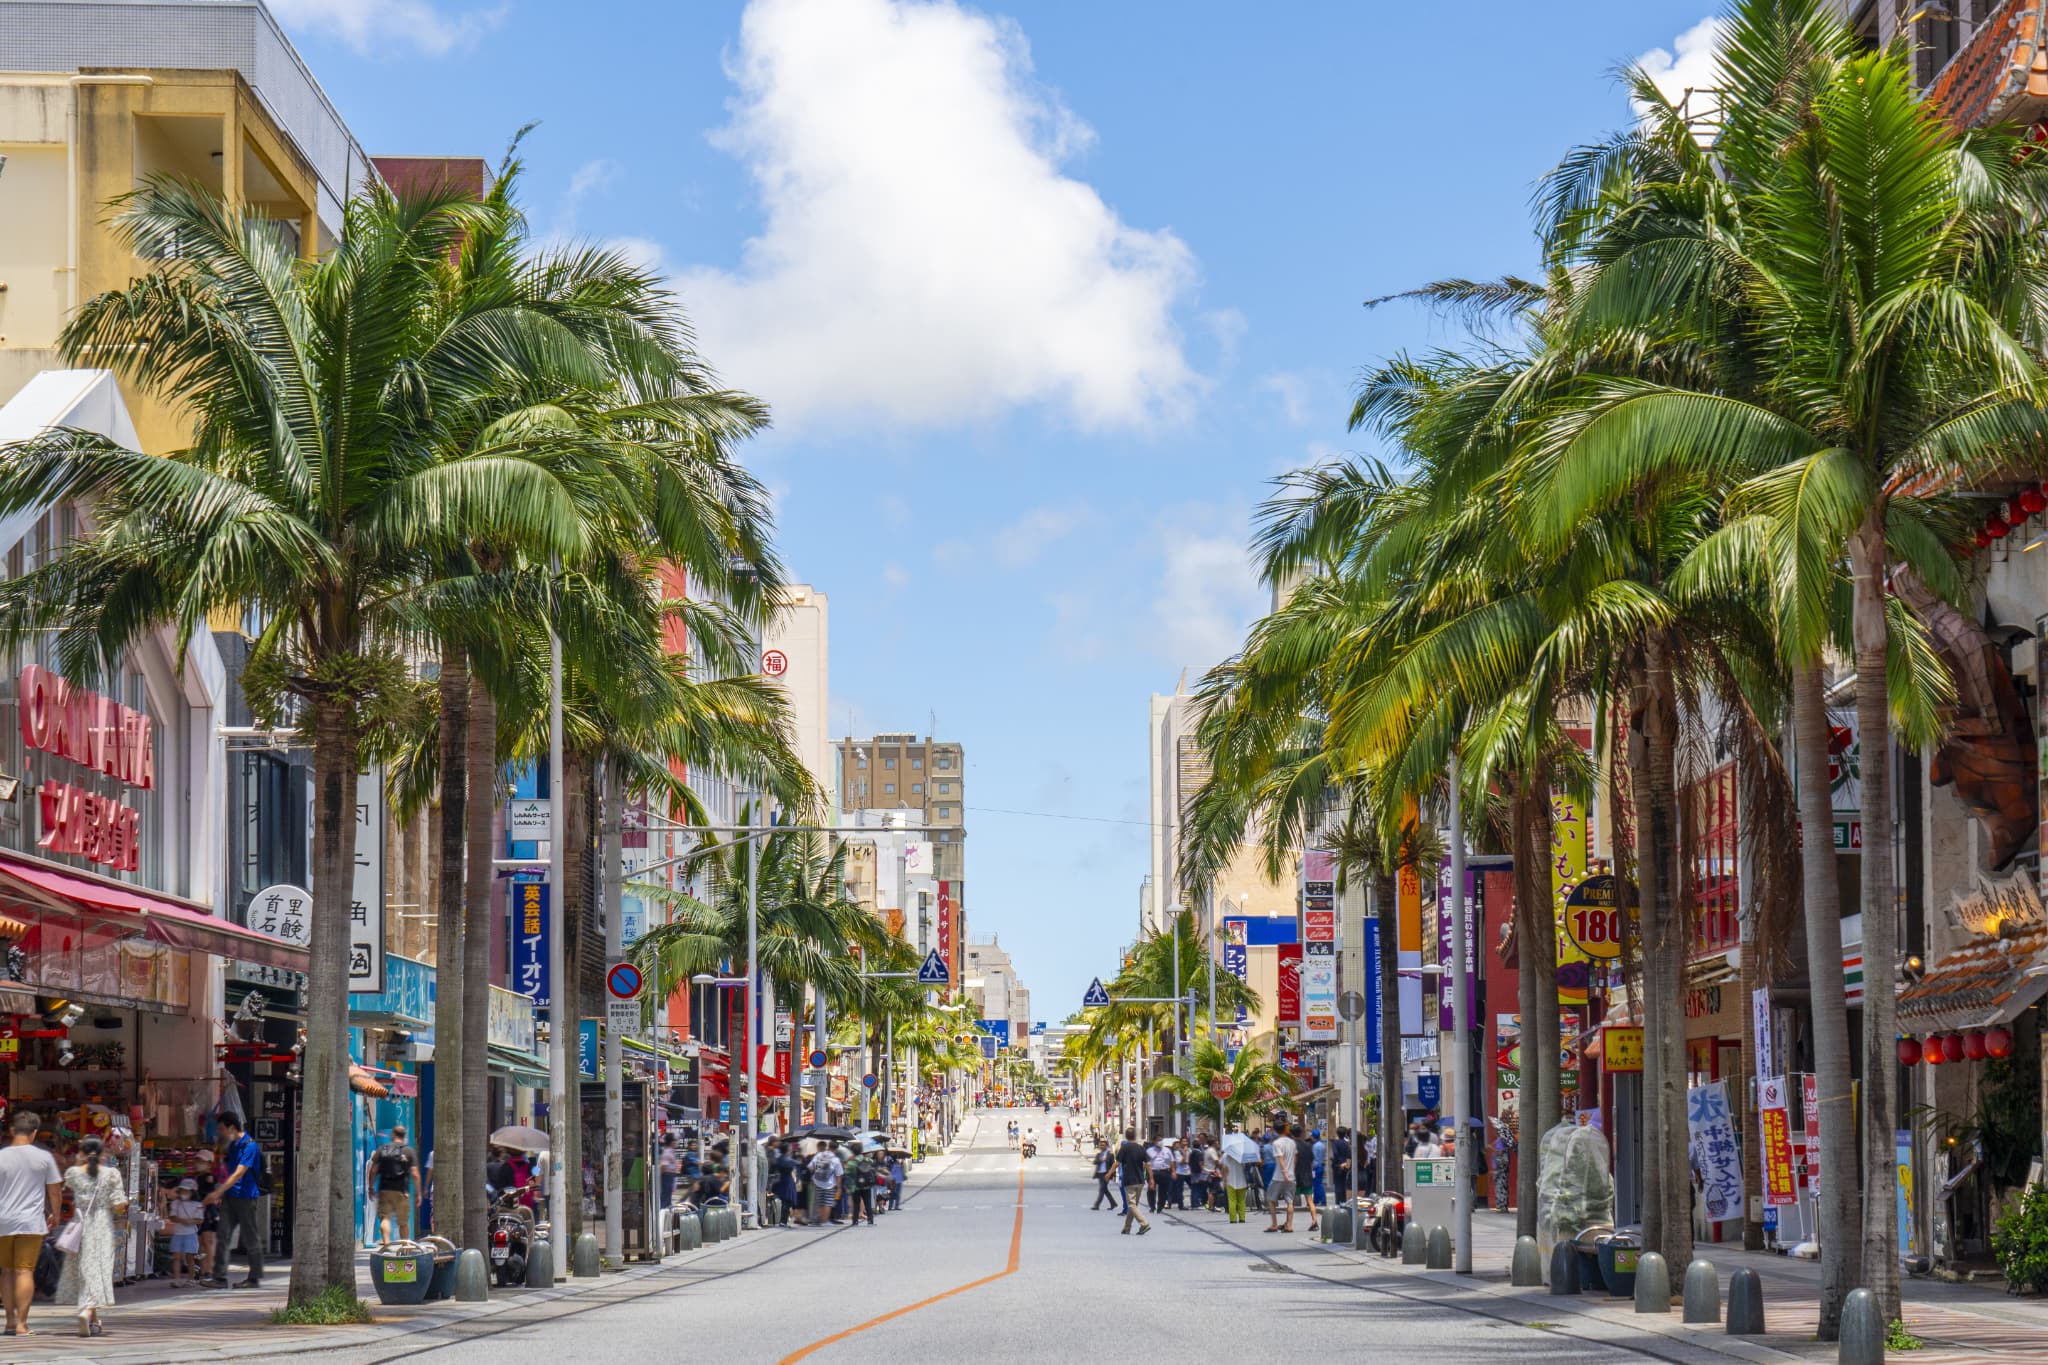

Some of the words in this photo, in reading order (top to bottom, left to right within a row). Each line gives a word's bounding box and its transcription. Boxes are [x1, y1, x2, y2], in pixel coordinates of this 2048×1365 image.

[766, 656, 782, 672] 福
[1583, 887, 1616, 900] PREMI
[522, 884, 543, 996] 英会話イーオン
